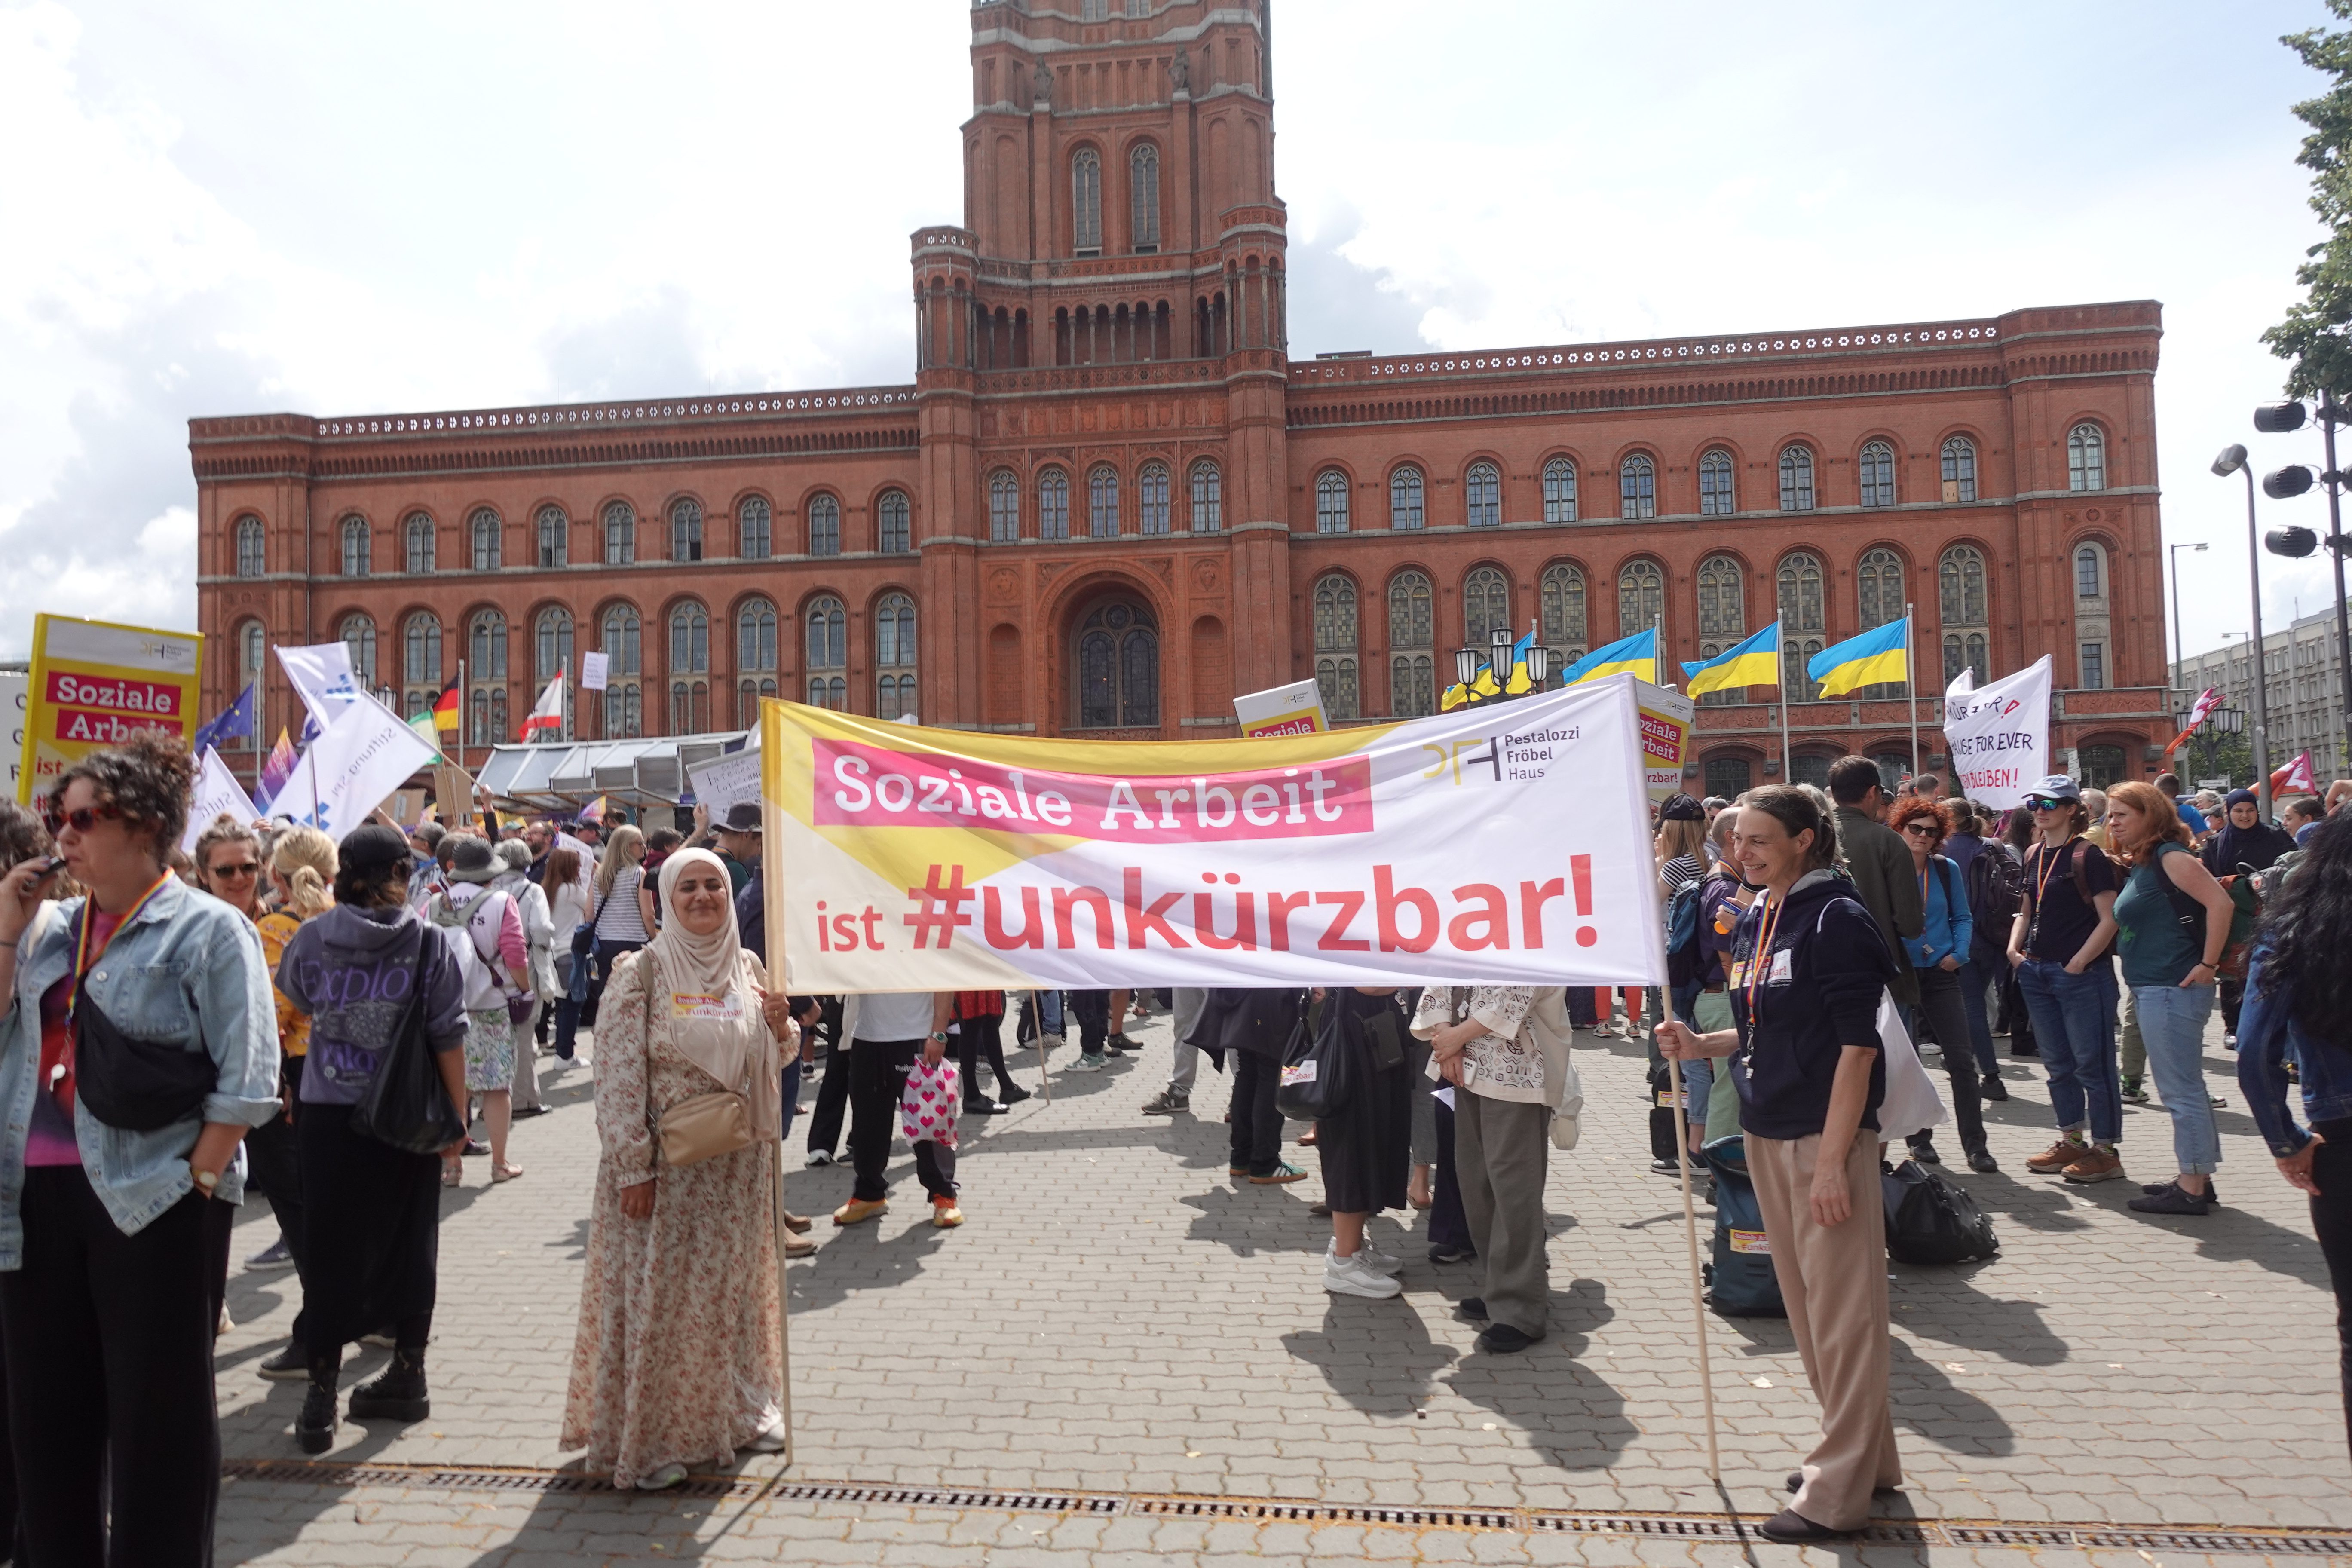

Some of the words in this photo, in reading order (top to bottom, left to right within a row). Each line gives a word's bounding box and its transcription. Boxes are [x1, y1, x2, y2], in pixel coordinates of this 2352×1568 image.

[57, 675, 172, 713] Soziale
[1505, 726, 1580, 747] Pestalozzi
[1639, 719, 1677, 741] oziale
[1642, 738, 1675, 760] rbeit
[1976, 735, 1994, 753] FOR
[1997, 732, 2033, 750] EVER
[37, 756, 64, 774] ist
[1507, 746, 1553, 763] Fröbel
[1509, 767, 1545, 780] Haus
[1647, 772, 1678, 783] rzbar!
[834, 755, 1072, 827] Soziale
[1099, 769, 1343, 830] Arbeit
[818, 906, 885, 952] ist
[904, 854, 1597, 953] #unkürzbar!
[301, 958, 410, 1011] Explo
